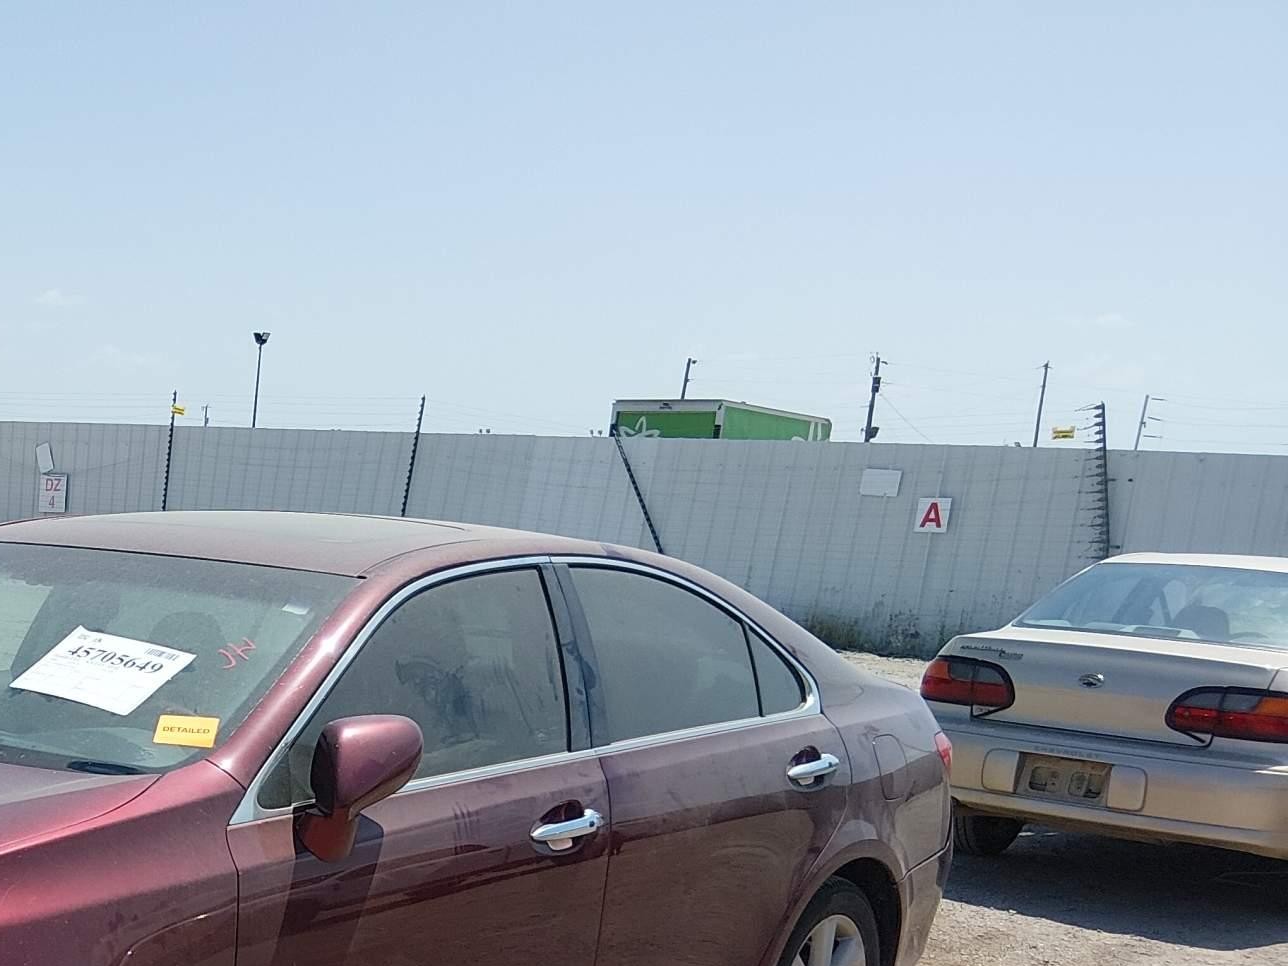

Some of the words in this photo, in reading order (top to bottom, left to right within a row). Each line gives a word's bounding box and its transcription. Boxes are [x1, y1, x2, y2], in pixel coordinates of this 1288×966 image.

[45, 478, 62, 492] DZ
[48, 495, 56, 509] 4
[919, 502, 942, 529] A
[68, 645, 164, 674] 45705649
[162, 726, 210, 735] DETAILED
